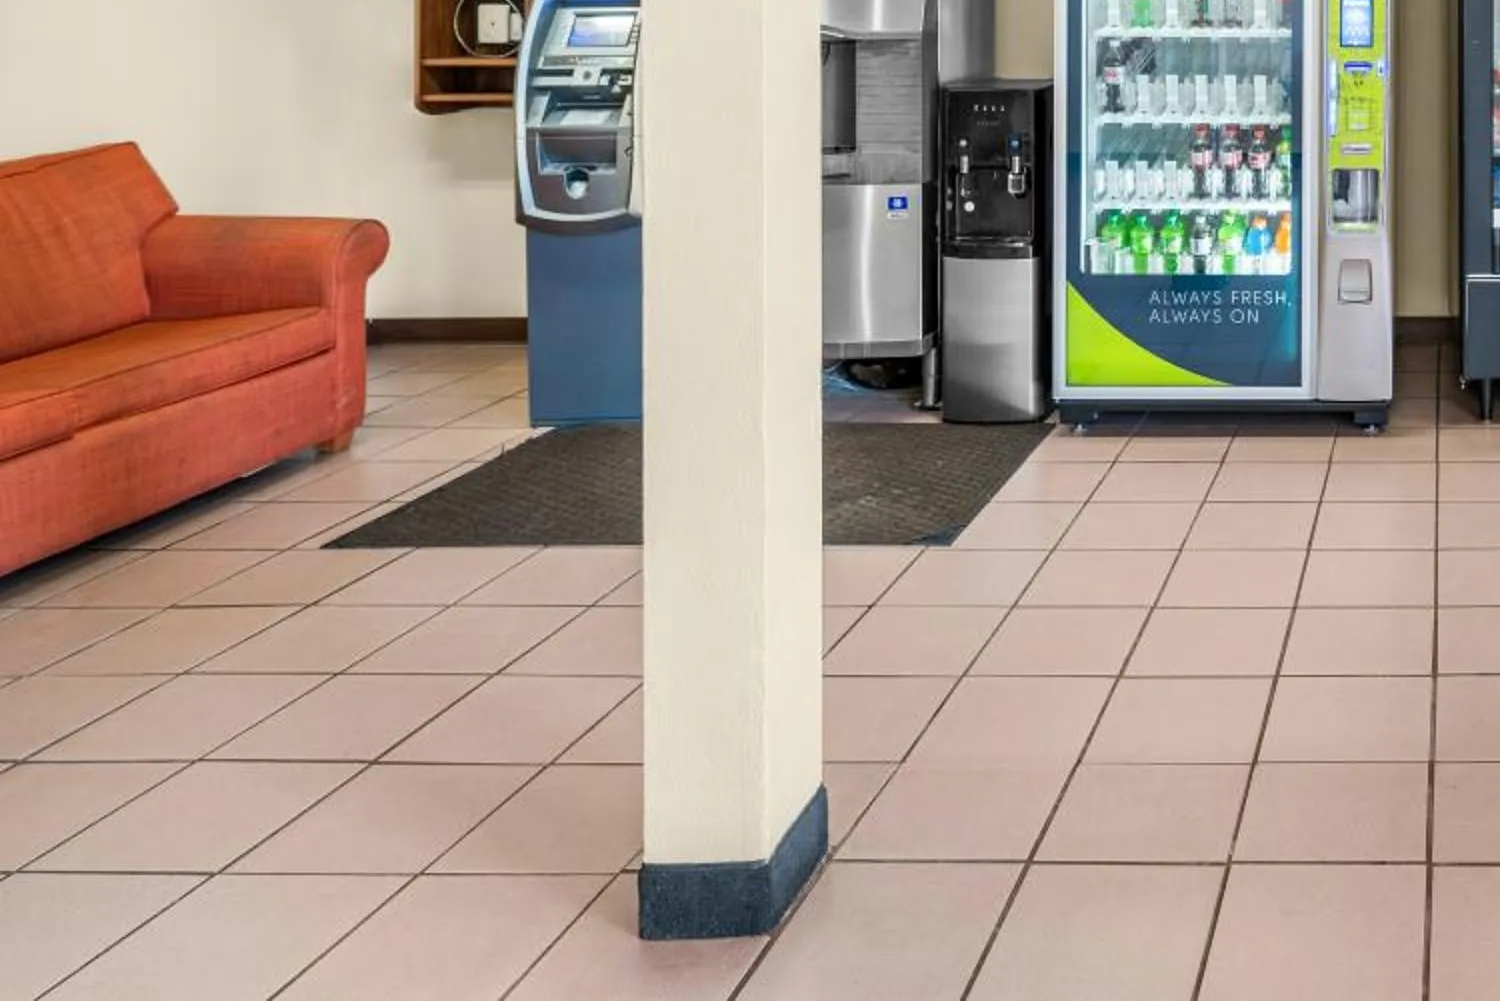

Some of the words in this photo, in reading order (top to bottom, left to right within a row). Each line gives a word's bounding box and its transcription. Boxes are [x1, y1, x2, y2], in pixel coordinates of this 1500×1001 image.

[1149, 290, 1222, 305] ALWAYS
[1149, 308, 1222, 324] ALWAYS
[1229, 308, 1259, 324] ON
